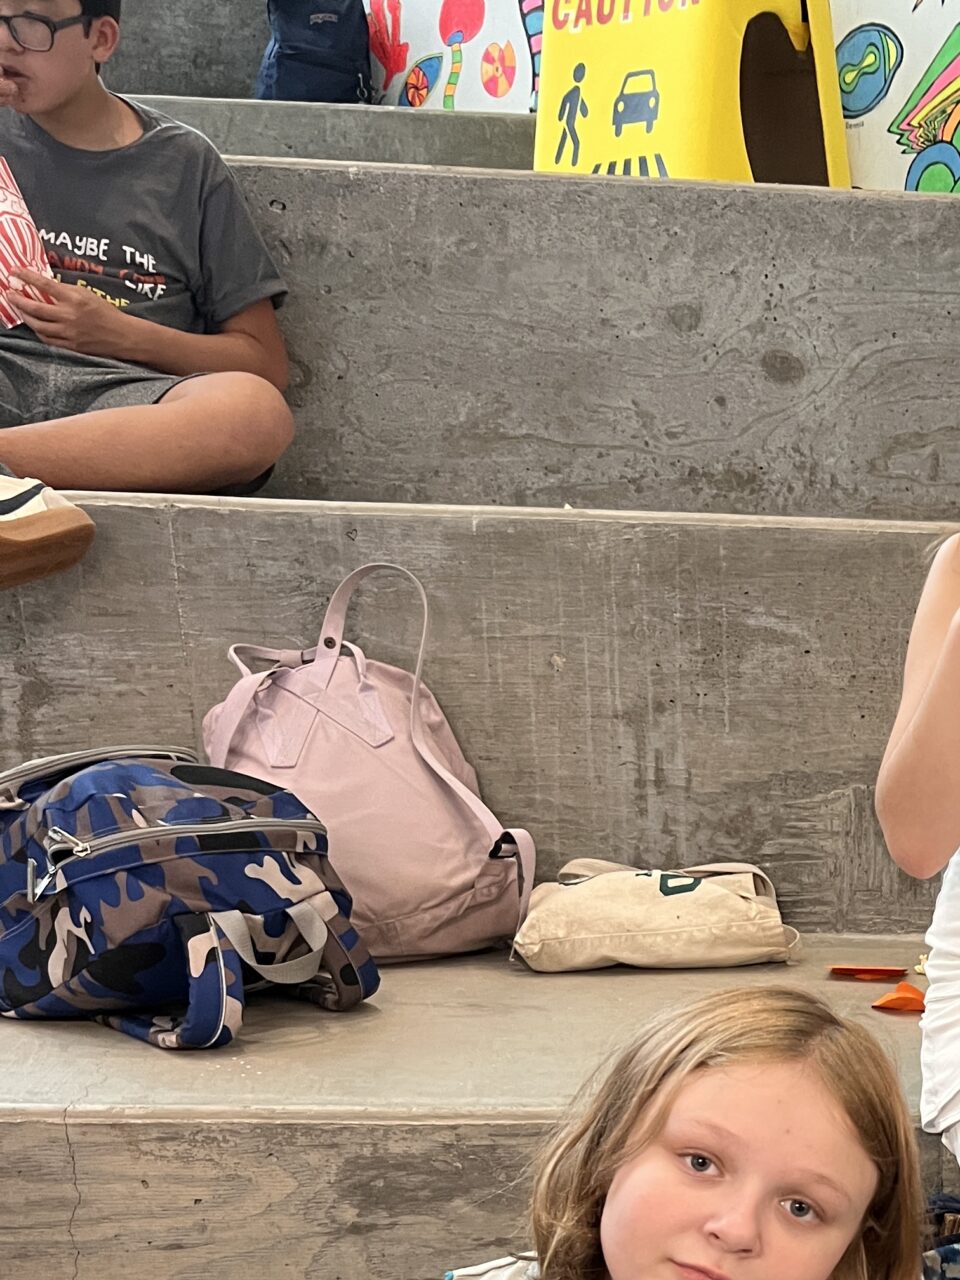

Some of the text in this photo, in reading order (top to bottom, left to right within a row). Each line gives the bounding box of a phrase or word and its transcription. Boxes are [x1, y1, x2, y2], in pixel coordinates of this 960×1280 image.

[552, 0, 699, 31] CAUT
[40, 228, 157, 273] MAYBE THE
[47, 250, 104, 274] ANDY
